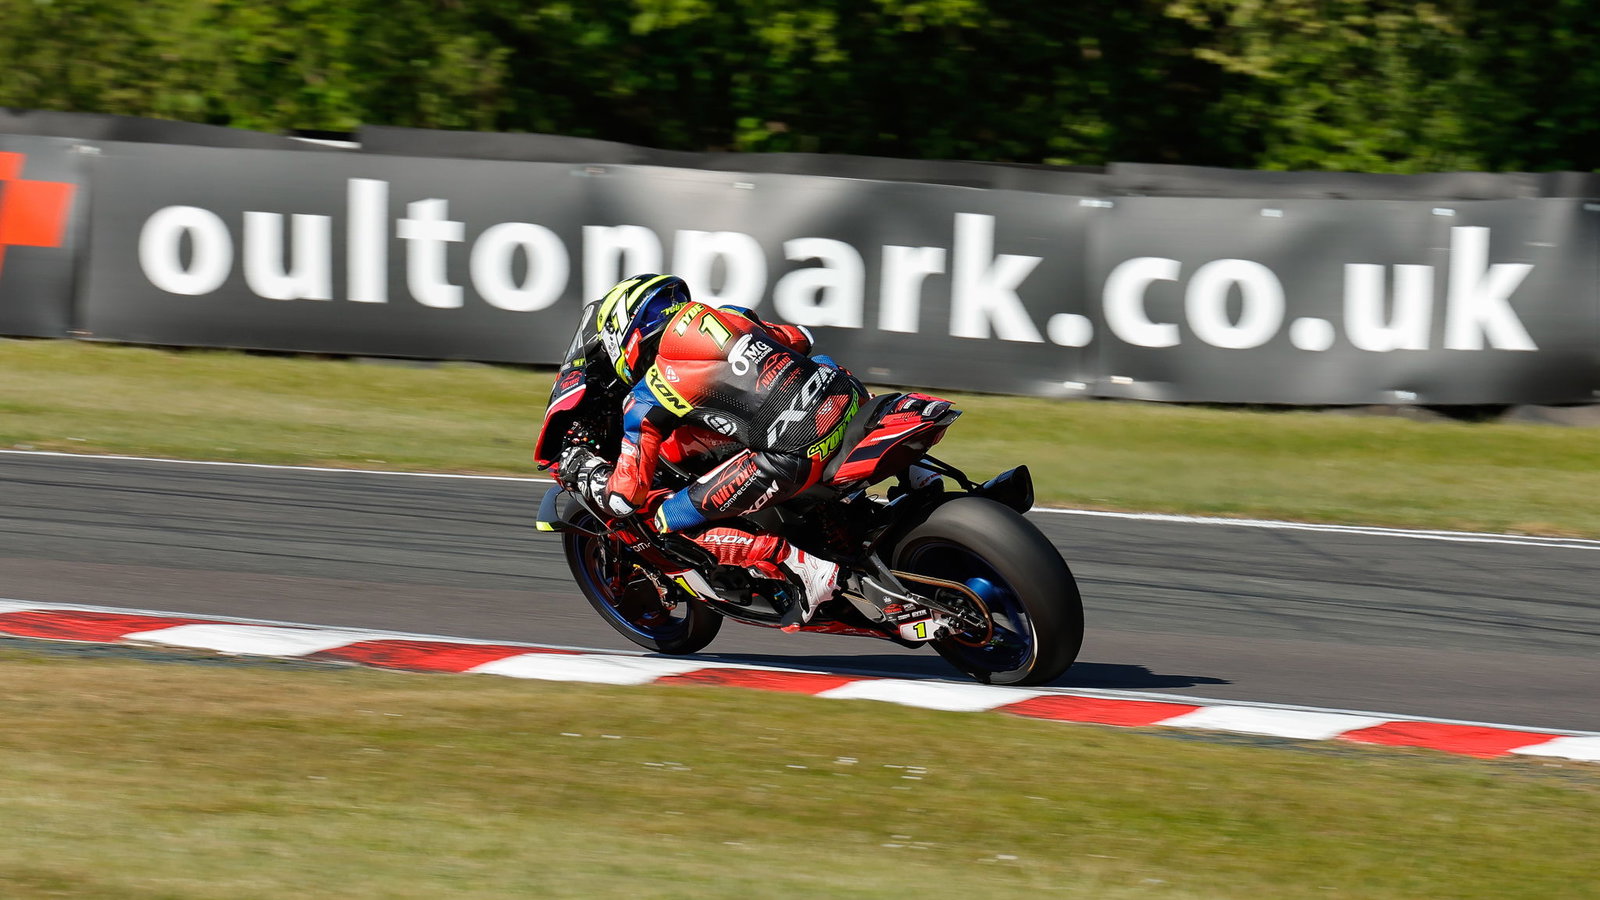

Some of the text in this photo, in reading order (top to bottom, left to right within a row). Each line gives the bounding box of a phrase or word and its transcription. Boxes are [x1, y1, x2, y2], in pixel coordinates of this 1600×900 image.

[699, 312, 733, 351] 1
[704, 534, 754, 546] IXON
[912, 621, 928, 640] 1
